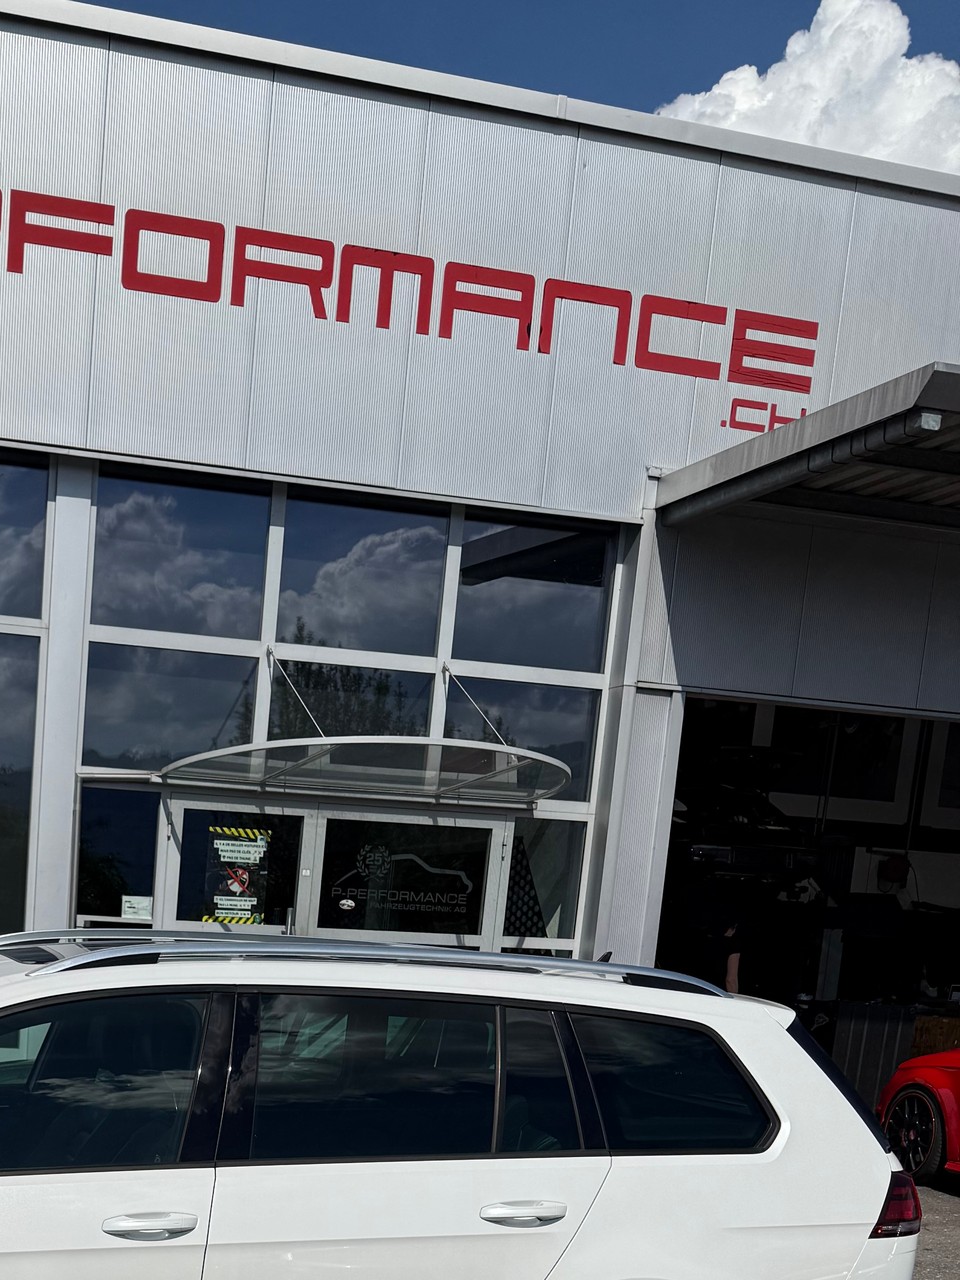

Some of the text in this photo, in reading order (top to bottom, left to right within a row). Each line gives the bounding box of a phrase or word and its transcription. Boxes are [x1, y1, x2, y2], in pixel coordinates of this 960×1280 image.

[366, 853, 383, 866] 25
[331, 887, 468, 905] P-PERFORMANCE
[369, 901, 453, 912] FAHRZEUGTECHNIK
